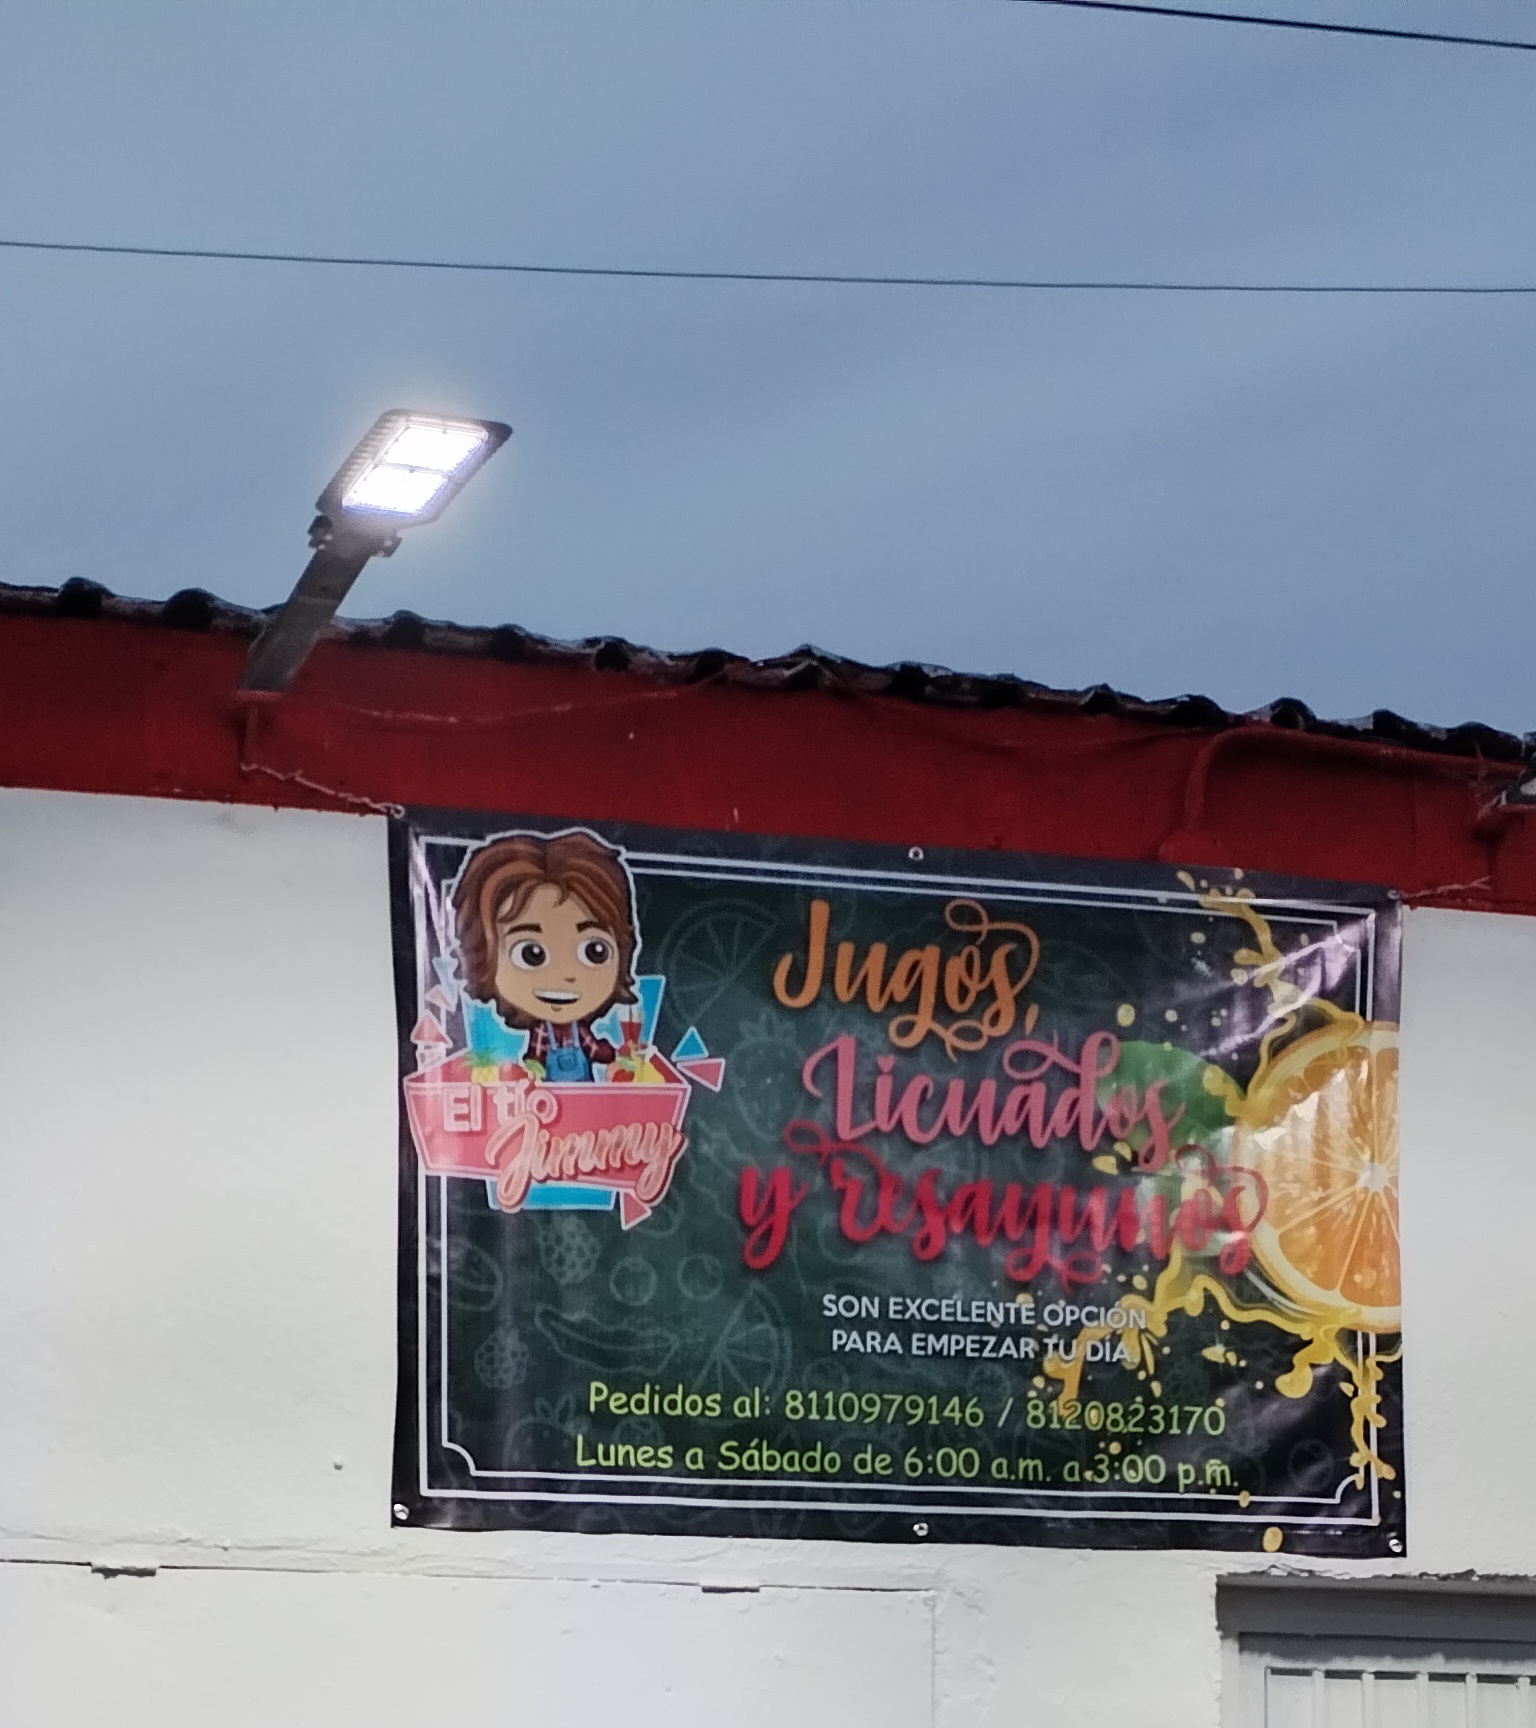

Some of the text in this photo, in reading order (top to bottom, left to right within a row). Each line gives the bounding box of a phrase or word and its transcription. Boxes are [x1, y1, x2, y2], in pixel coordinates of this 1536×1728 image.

[442, 1084, 482, 1132] El
[801, 1030, 1186, 1171] Licuados
[484, 1111, 688, 1212] Jimmy
[740, 1166, 810, 1270] y
[822, 1294, 880, 1319] SON
[888, 1297, 1035, 1326] EXCELENTE
[832, 1329, 902, 1354] PARA
[912, 1333, 1035, 1360] EMPEZAR
[1043, 1337, 1077, 1361] TU
[589, 1381, 1226, 1435] Pedidos al: 8110979146 / 8120823170
[576, 1433, 1239, 1494] Lunes a Sábado de 6:00 a.m. a 3:00 p.m.
